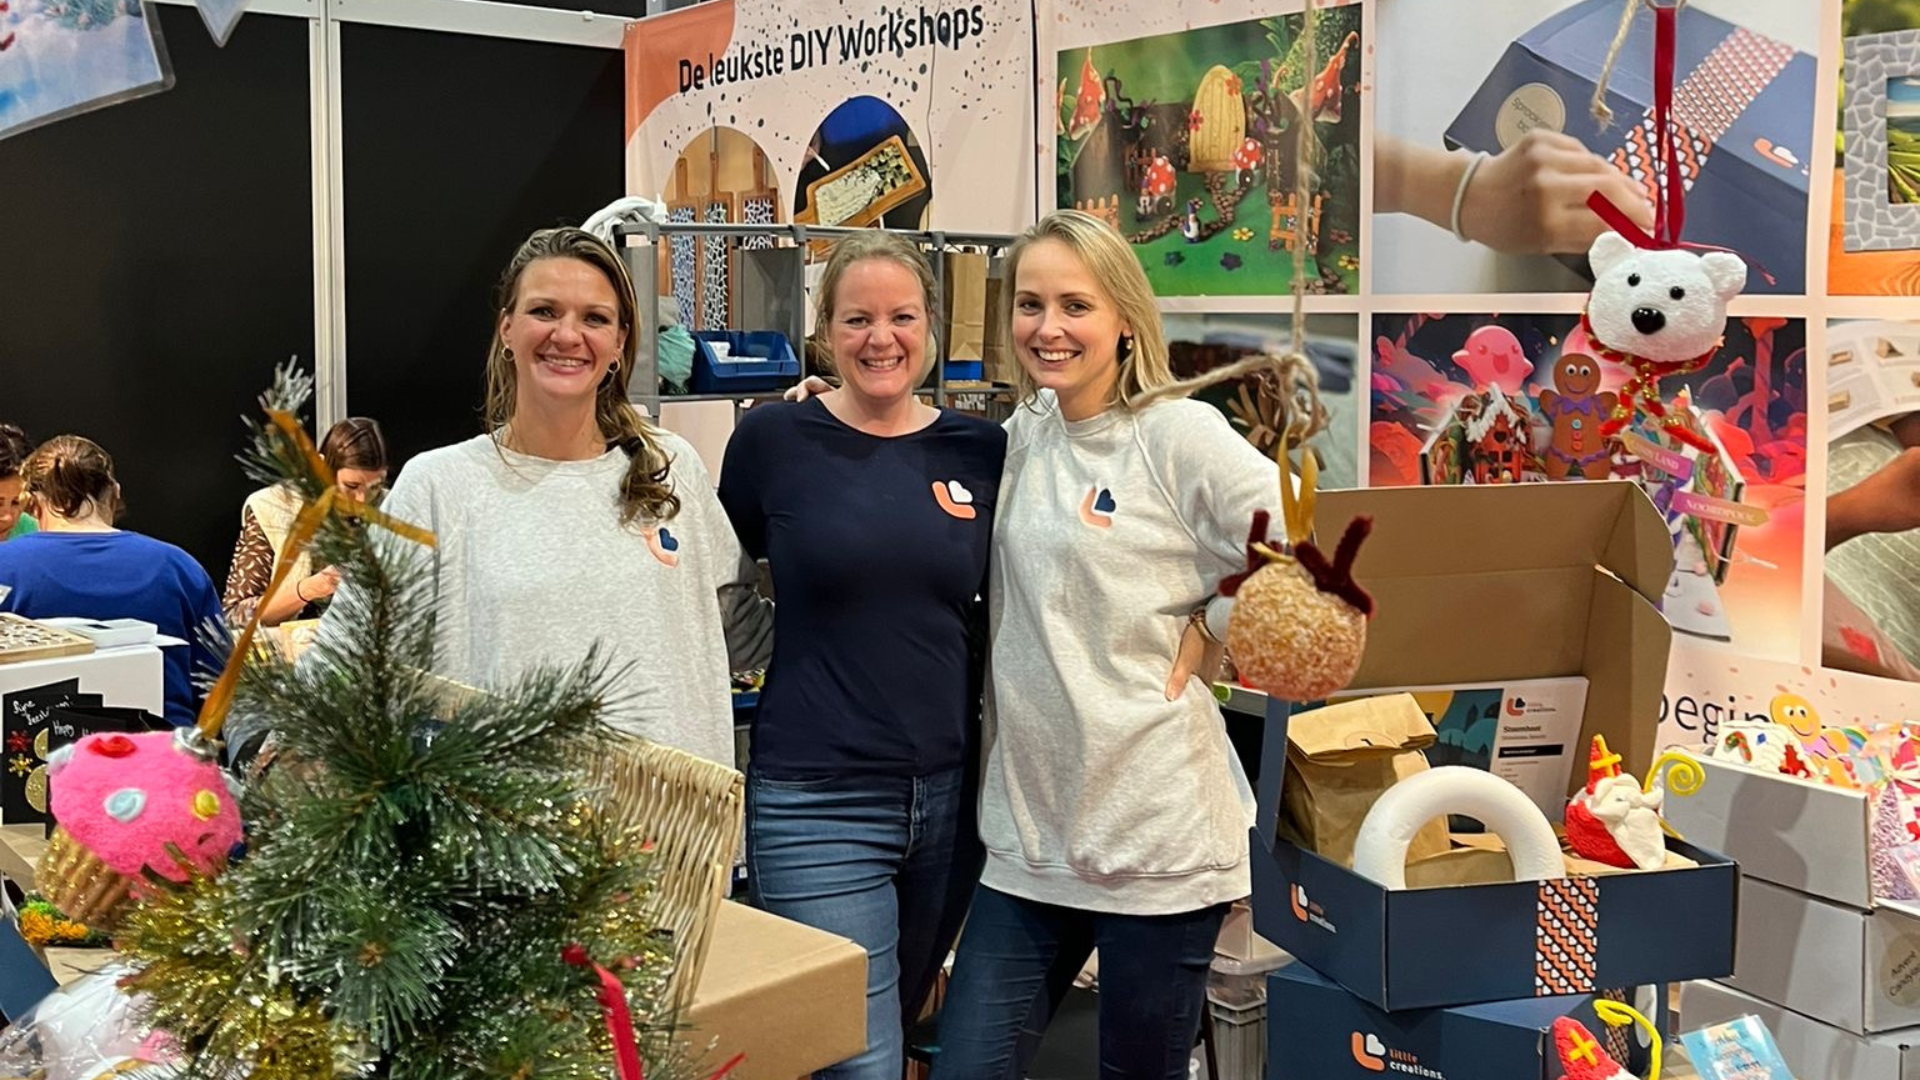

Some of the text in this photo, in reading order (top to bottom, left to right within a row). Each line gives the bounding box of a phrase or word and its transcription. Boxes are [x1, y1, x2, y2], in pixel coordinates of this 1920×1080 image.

[679, 5, 984, 93] De leukste DIY Workshops
[1389, 1047, 1419, 1064] little
